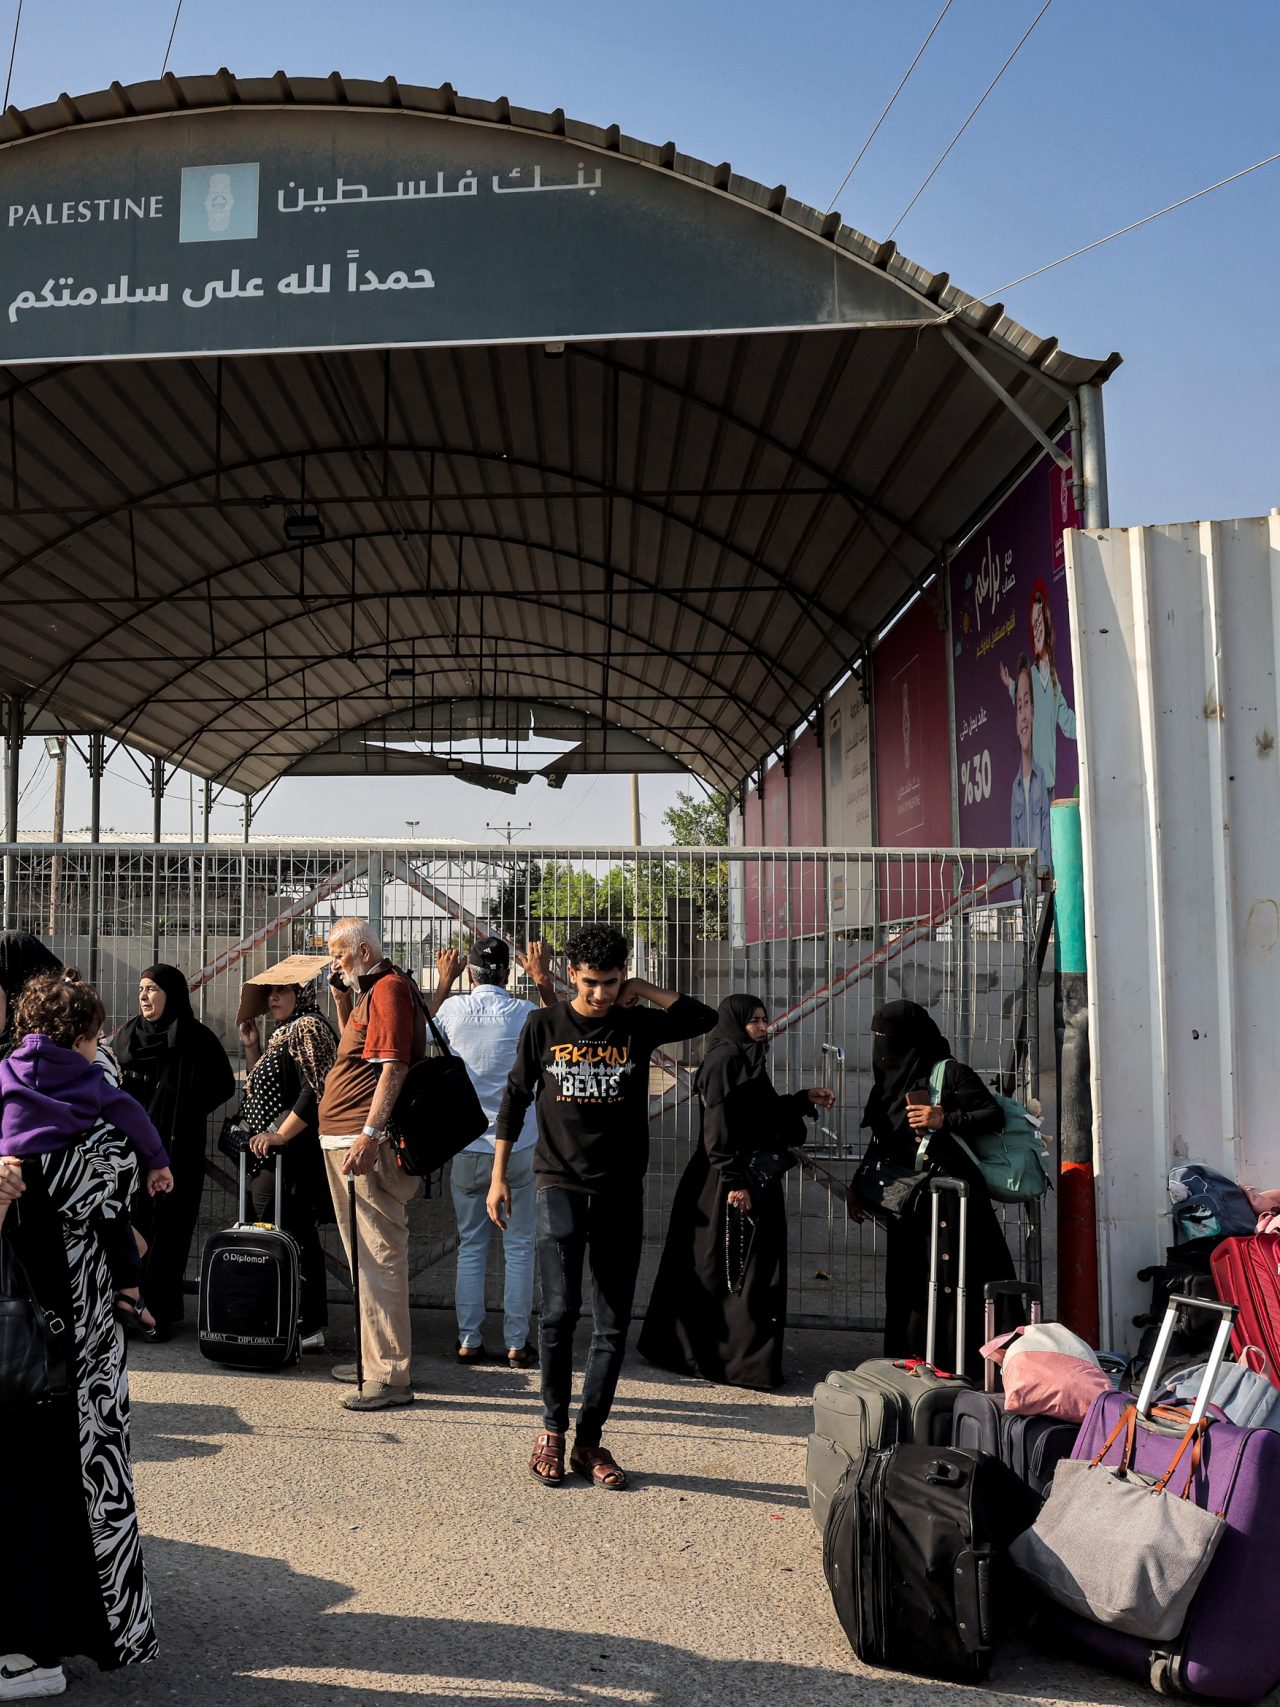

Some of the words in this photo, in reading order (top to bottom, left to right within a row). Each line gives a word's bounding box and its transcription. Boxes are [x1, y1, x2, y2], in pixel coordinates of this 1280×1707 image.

[278, 169, 478, 213] فلسطين
[492, 162, 602, 196] بنك
[8, 195, 164, 227] PALESTINE
[182, 268, 265, 309] على
[277, 263, 331, 295] لله
[8, 275, 169, 324] سلامتكم
[550, 1043, 628, 1067] BKLYN
[556, 1095, 572, 1103] NEW
[577, 1096, 603, 1105] YORK
[562, 1075, 621, 1097] BEATS
[230, 1253, 266, 1264] Diplomat
